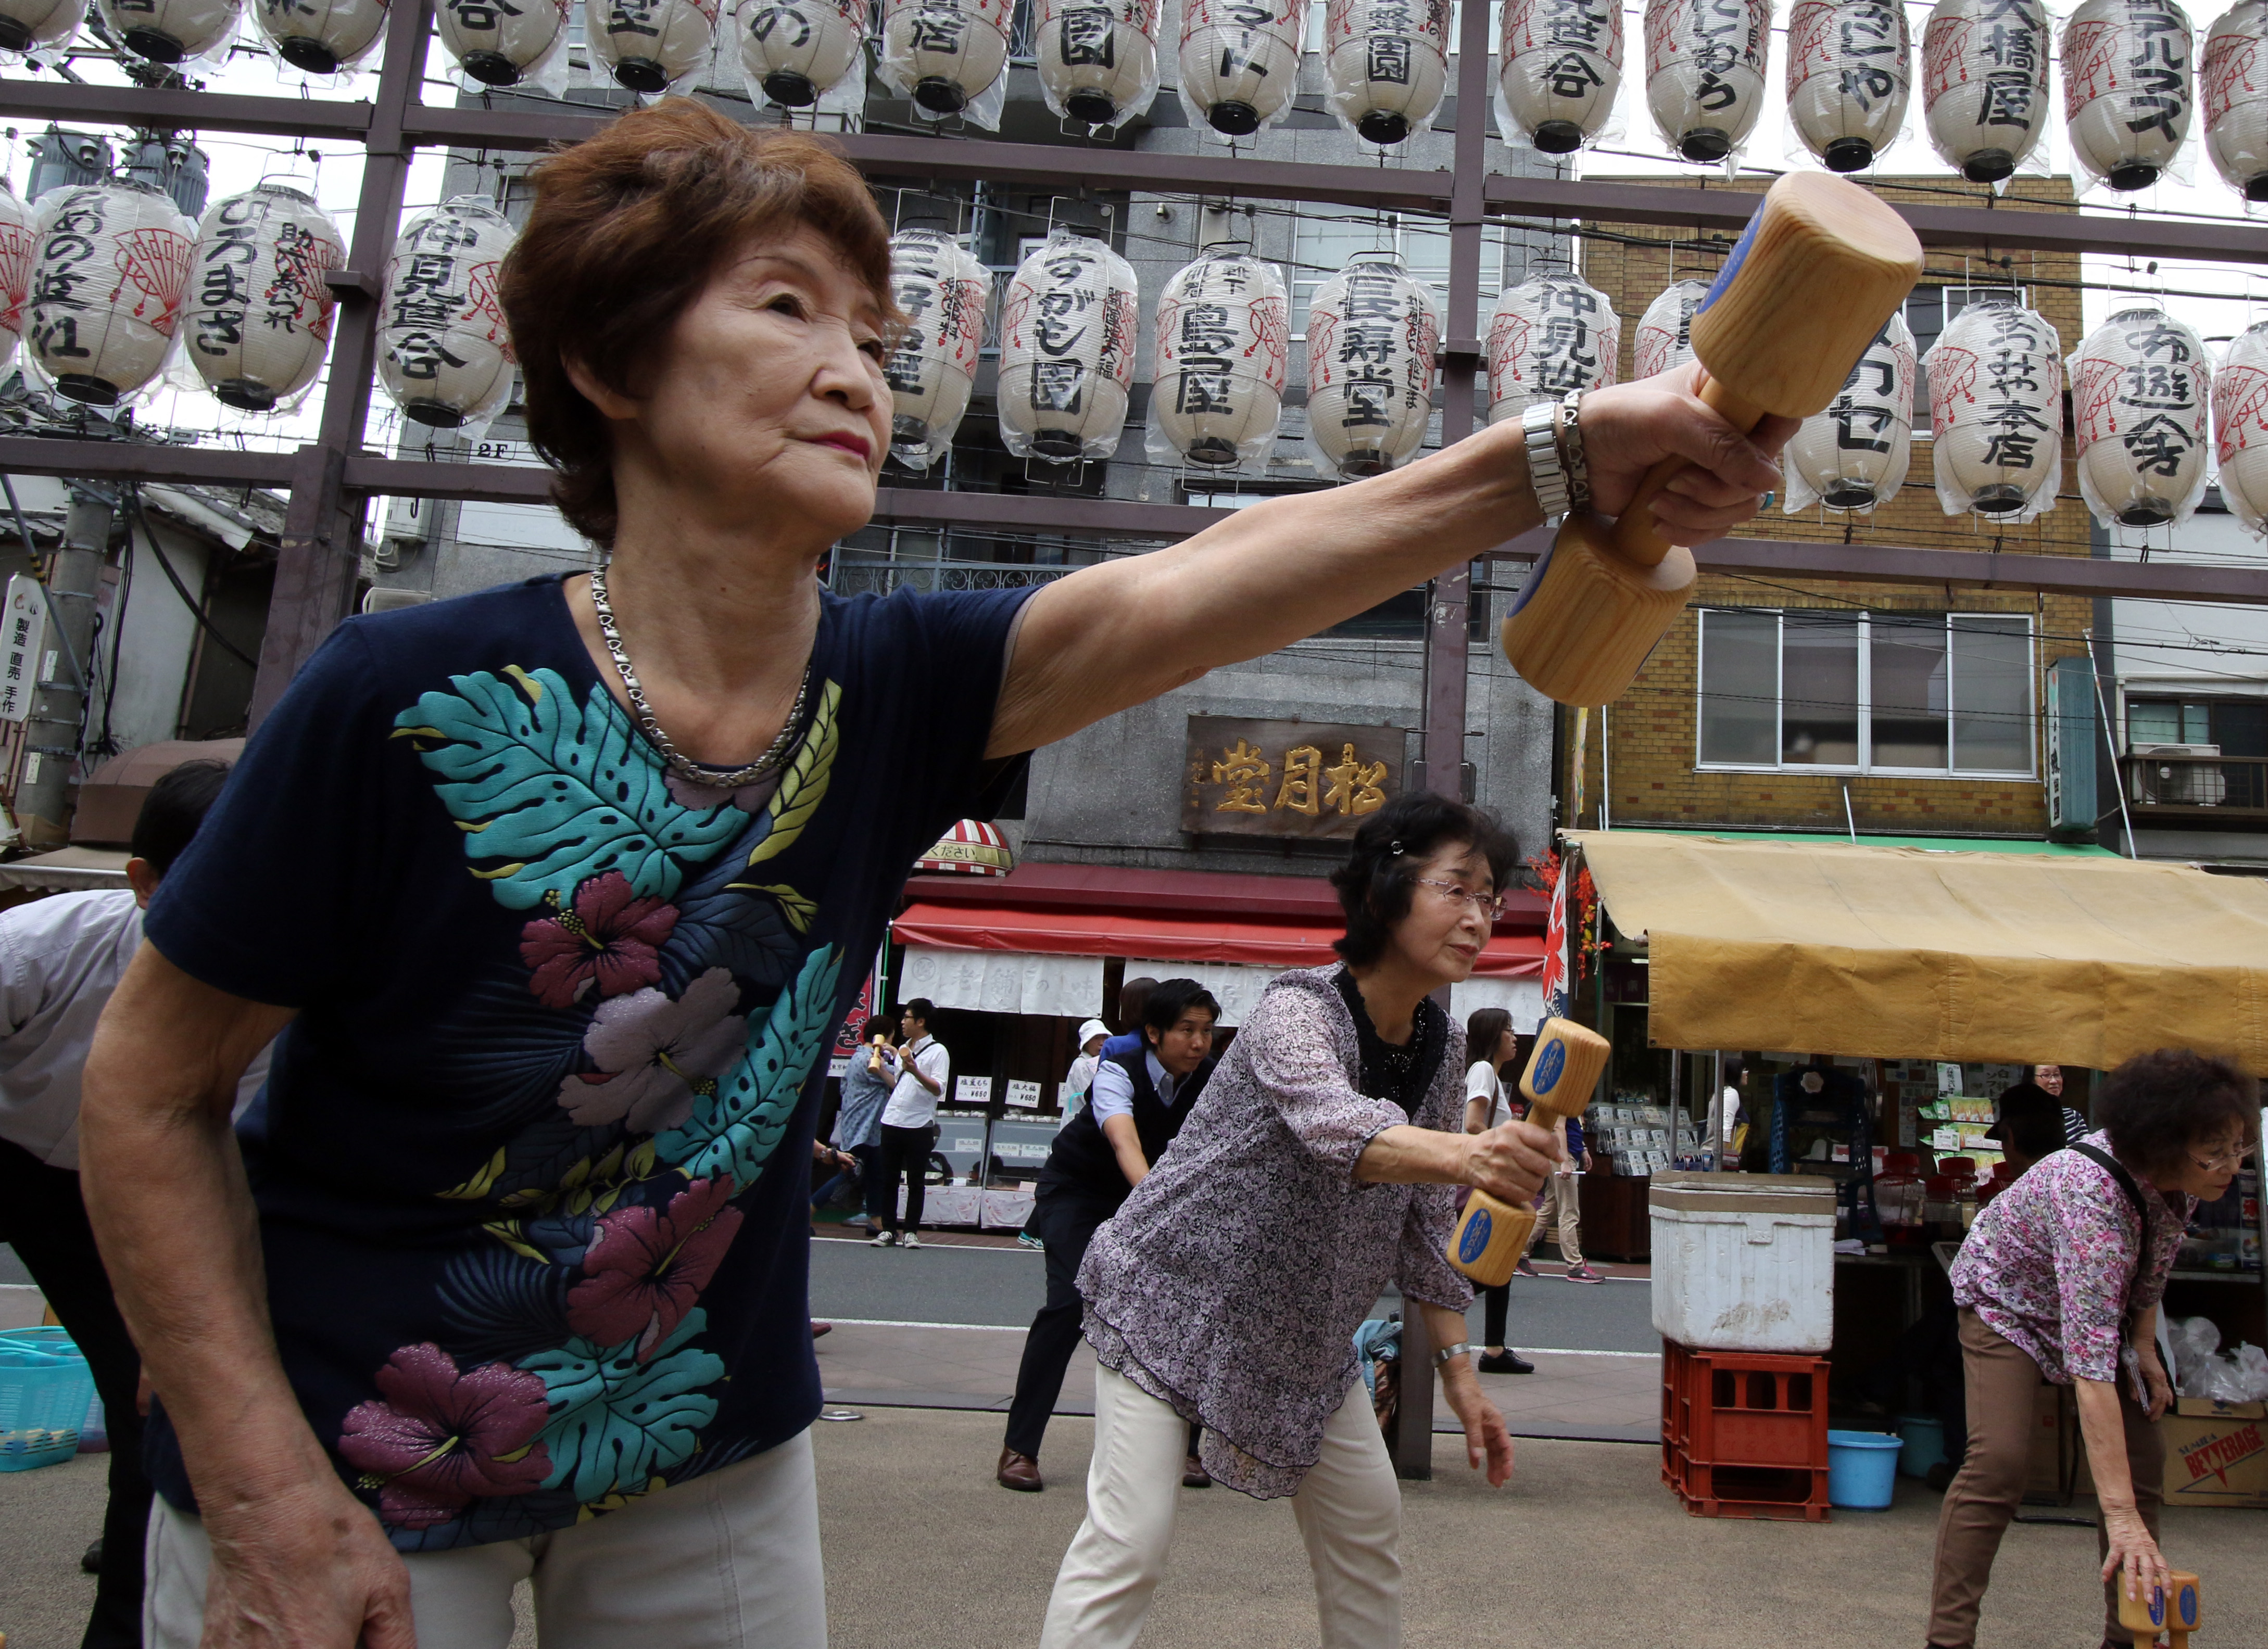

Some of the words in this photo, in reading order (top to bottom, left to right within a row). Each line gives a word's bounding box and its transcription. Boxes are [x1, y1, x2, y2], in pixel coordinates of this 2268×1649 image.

[386, 219, 479, 379] 仲見世会
[1339, 275, 1400, 428] 長寿堂
[1525, 284, 1596, 402] 仲見世
[477, 443, 508, 458] 2F
[13, 617, 30, 646] 製造
[8, 651, 24, 680] 直売
[2, 686, 17, 714] 手作
[960, 1078, 988, 1086] 塩豆もち
[1012, 1083, 1036, 1092] 塩大福
[1020, 1093, 1037, 1102] ¥650
[2184, 1423, 2265, 1488] BEVERAGE
